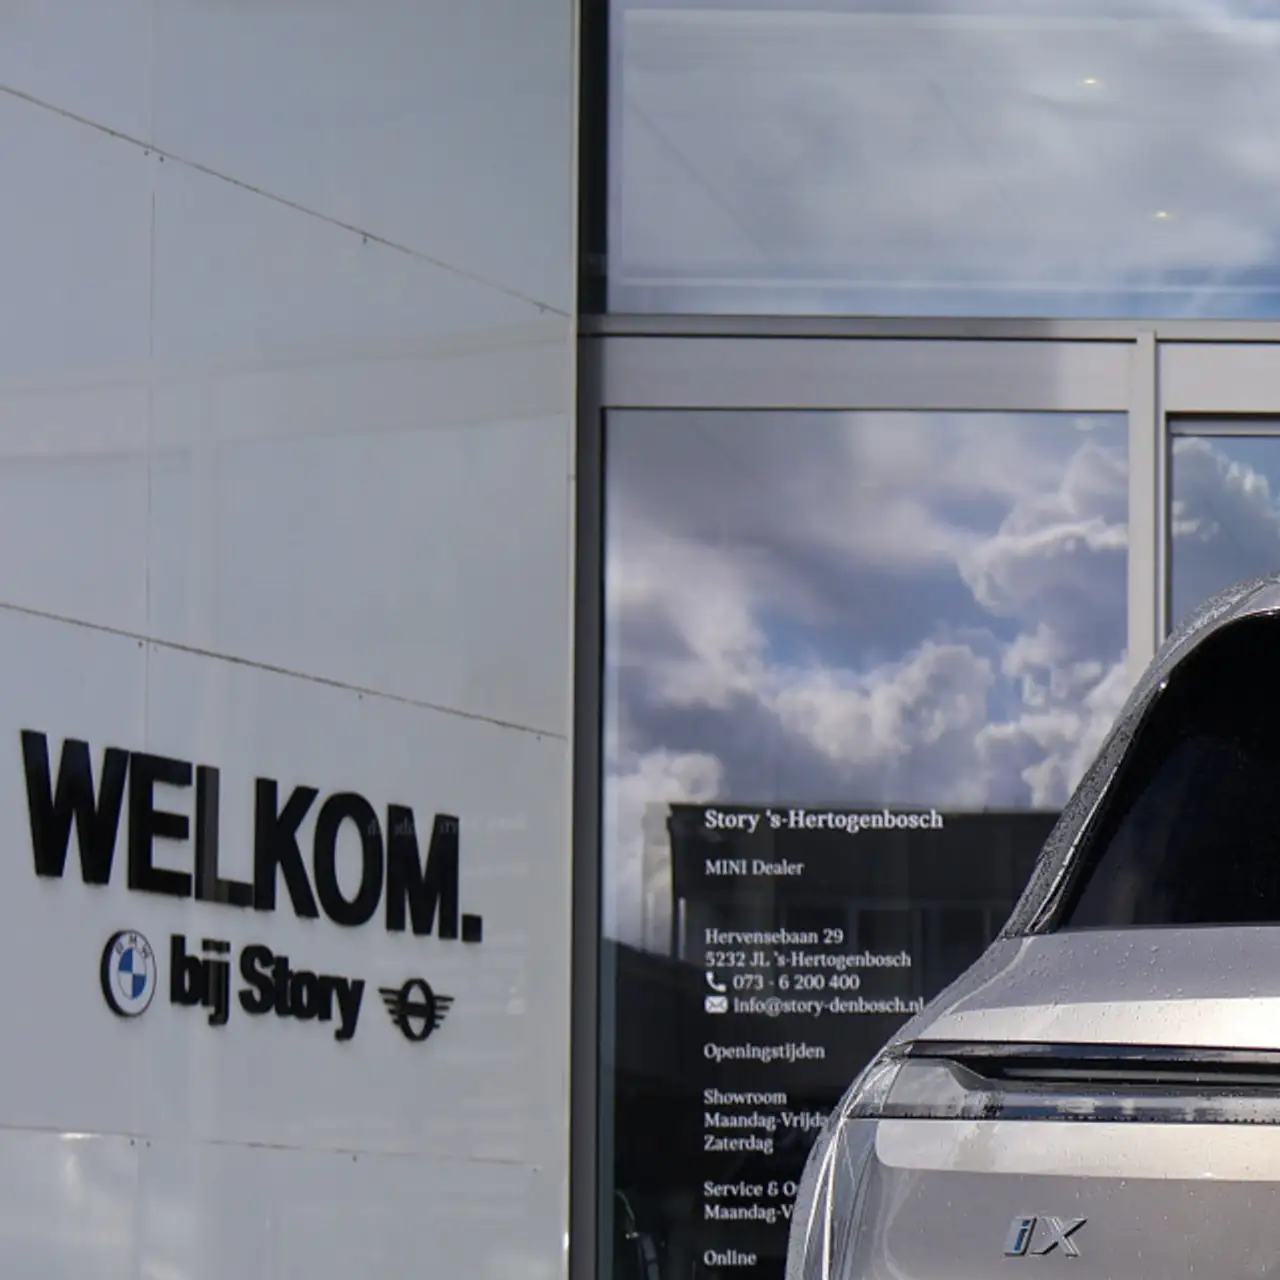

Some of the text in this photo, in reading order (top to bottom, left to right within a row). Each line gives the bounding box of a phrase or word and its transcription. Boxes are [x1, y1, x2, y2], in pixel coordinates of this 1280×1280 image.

[705, 809, 944, 833] Story 's-Hertogenbosch
[20, 729, 483, 943] WELKOM.
[705, 858, 804, 876] MINI Dealer
[705, 928, 844, 946] Hervensebaan 29
[705, 951, 912, 971] 5232 JL 's-Hertogenbosch
[170, 934, 365, 1041] bij Story
[733, 975, 764, 990] 073
[778, 975, 789, 990] 6
[794, 974, 826, 991] 200
[829, 974, 860, 991] 400
[703, 1044, 826, 1062] Openingstijden
[704, 1089, 787, 1105] Showroom
[704, 1134, 774, 1154] Zaterdag
[704, 1180, 763, 1197] Service
[704, 1250, 757, 1266] Online
